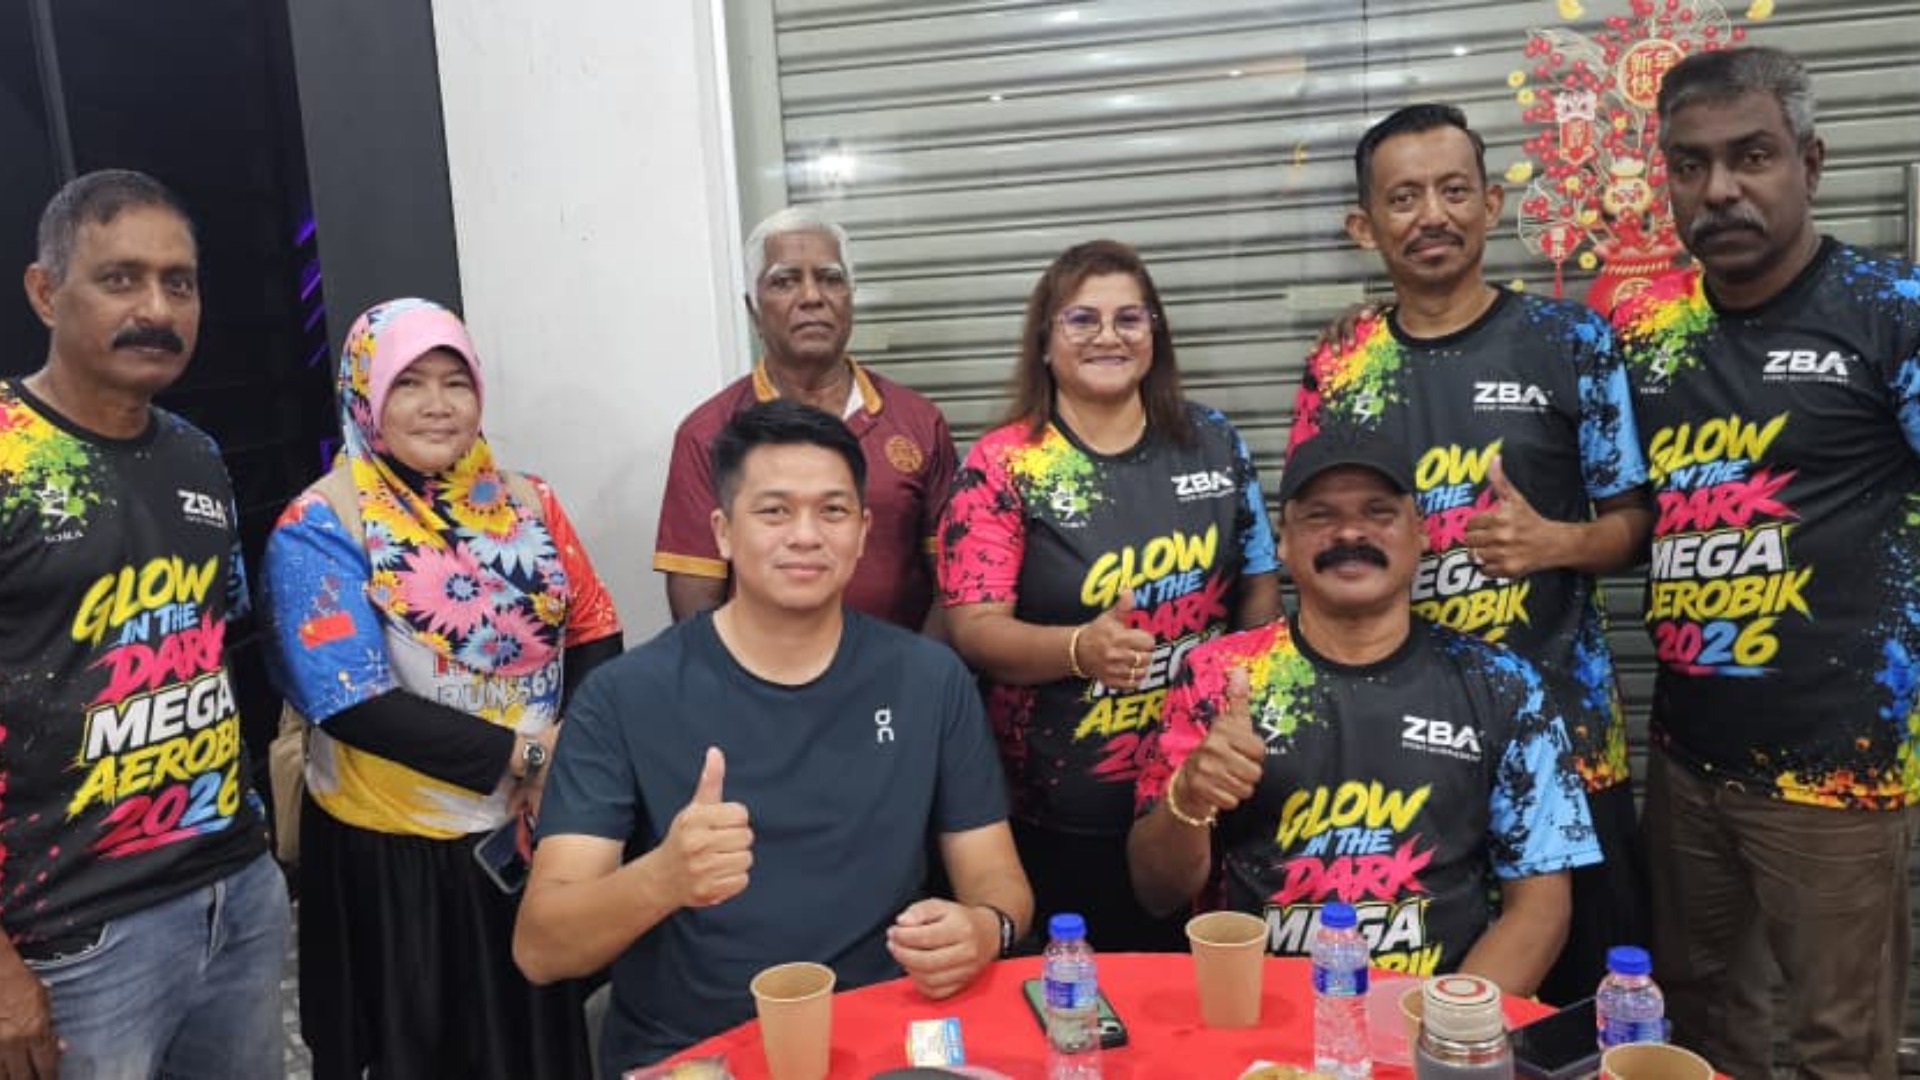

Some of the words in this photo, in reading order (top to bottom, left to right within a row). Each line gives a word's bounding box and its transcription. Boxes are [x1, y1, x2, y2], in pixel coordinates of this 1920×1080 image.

[1762, 350, 1849, 375] ZBA
[1473, 382, 1549, 406] ZBA
[1415, 438, 1504, 490] OW
[1649, 411, 1789, 489] GLOW
[1694, 458, 1750, 487] THE
[177, 489, 227, 523] ZBA
[1170, 470, 1234, 496] ZBA
[1653, 466, 1800, 537] DARK
[1080, 521, 1219, 609] GLOW
[1152, 567, 1203, 604] THE
[71, 554, 219, 648] GLOW
[117, 610, 150, 645] IN
[153, 601, 200, 636] THE
[1654, 615, 1780, 668] 2026
[86, 669, 236, 760] MEGA
[1401, 714, 1483, 753] ZBA
[94, 761, 240, 850] 2026
[1275, 779, 1433, 852] GLOW
[1335, 827, 1394, 857] THE
[1269, 833, 1435, 905] DARK
